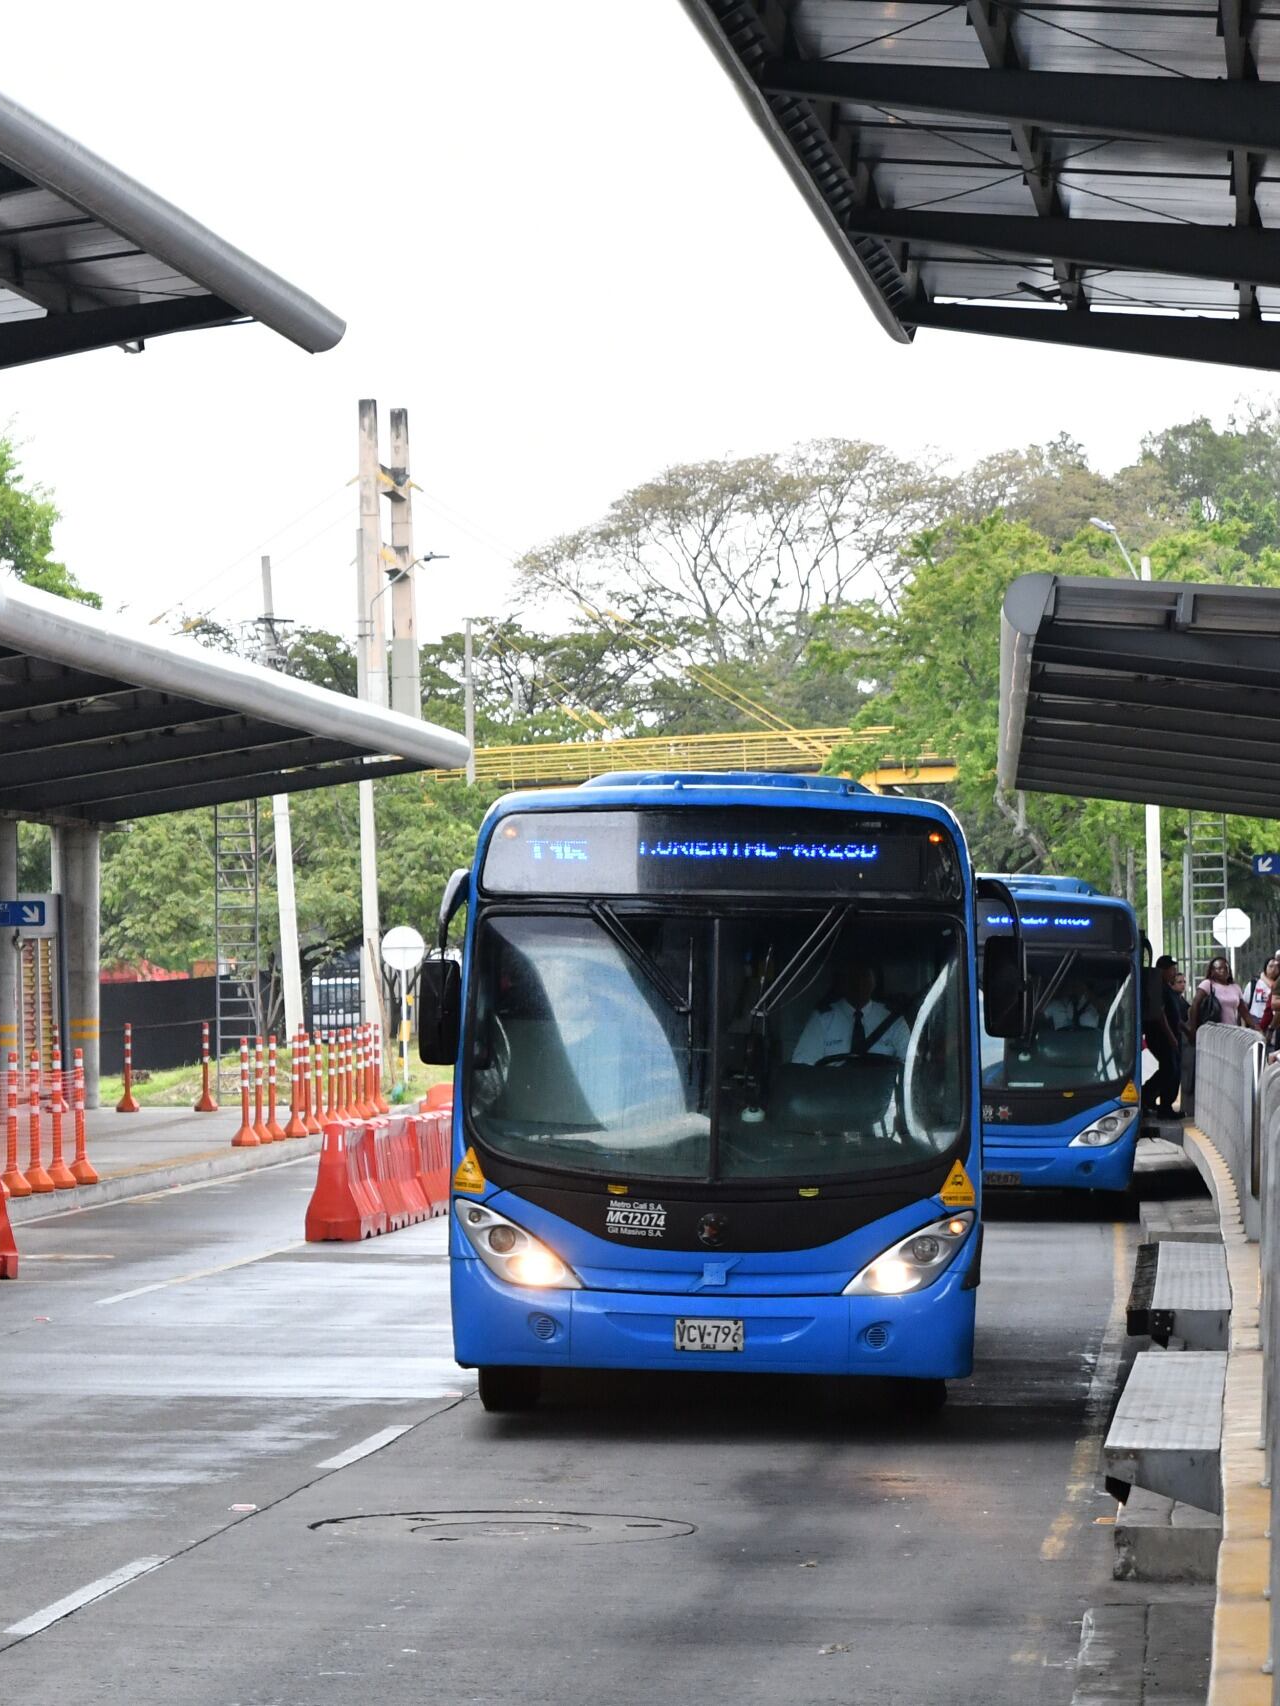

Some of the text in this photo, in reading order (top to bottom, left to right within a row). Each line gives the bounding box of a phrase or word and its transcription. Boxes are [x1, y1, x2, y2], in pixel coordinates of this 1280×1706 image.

[609, 1200, 631, 1209] Metro
[606, 1211, 666, 1227] MC12074
[620, 1227, 647, 1236] Masivo
